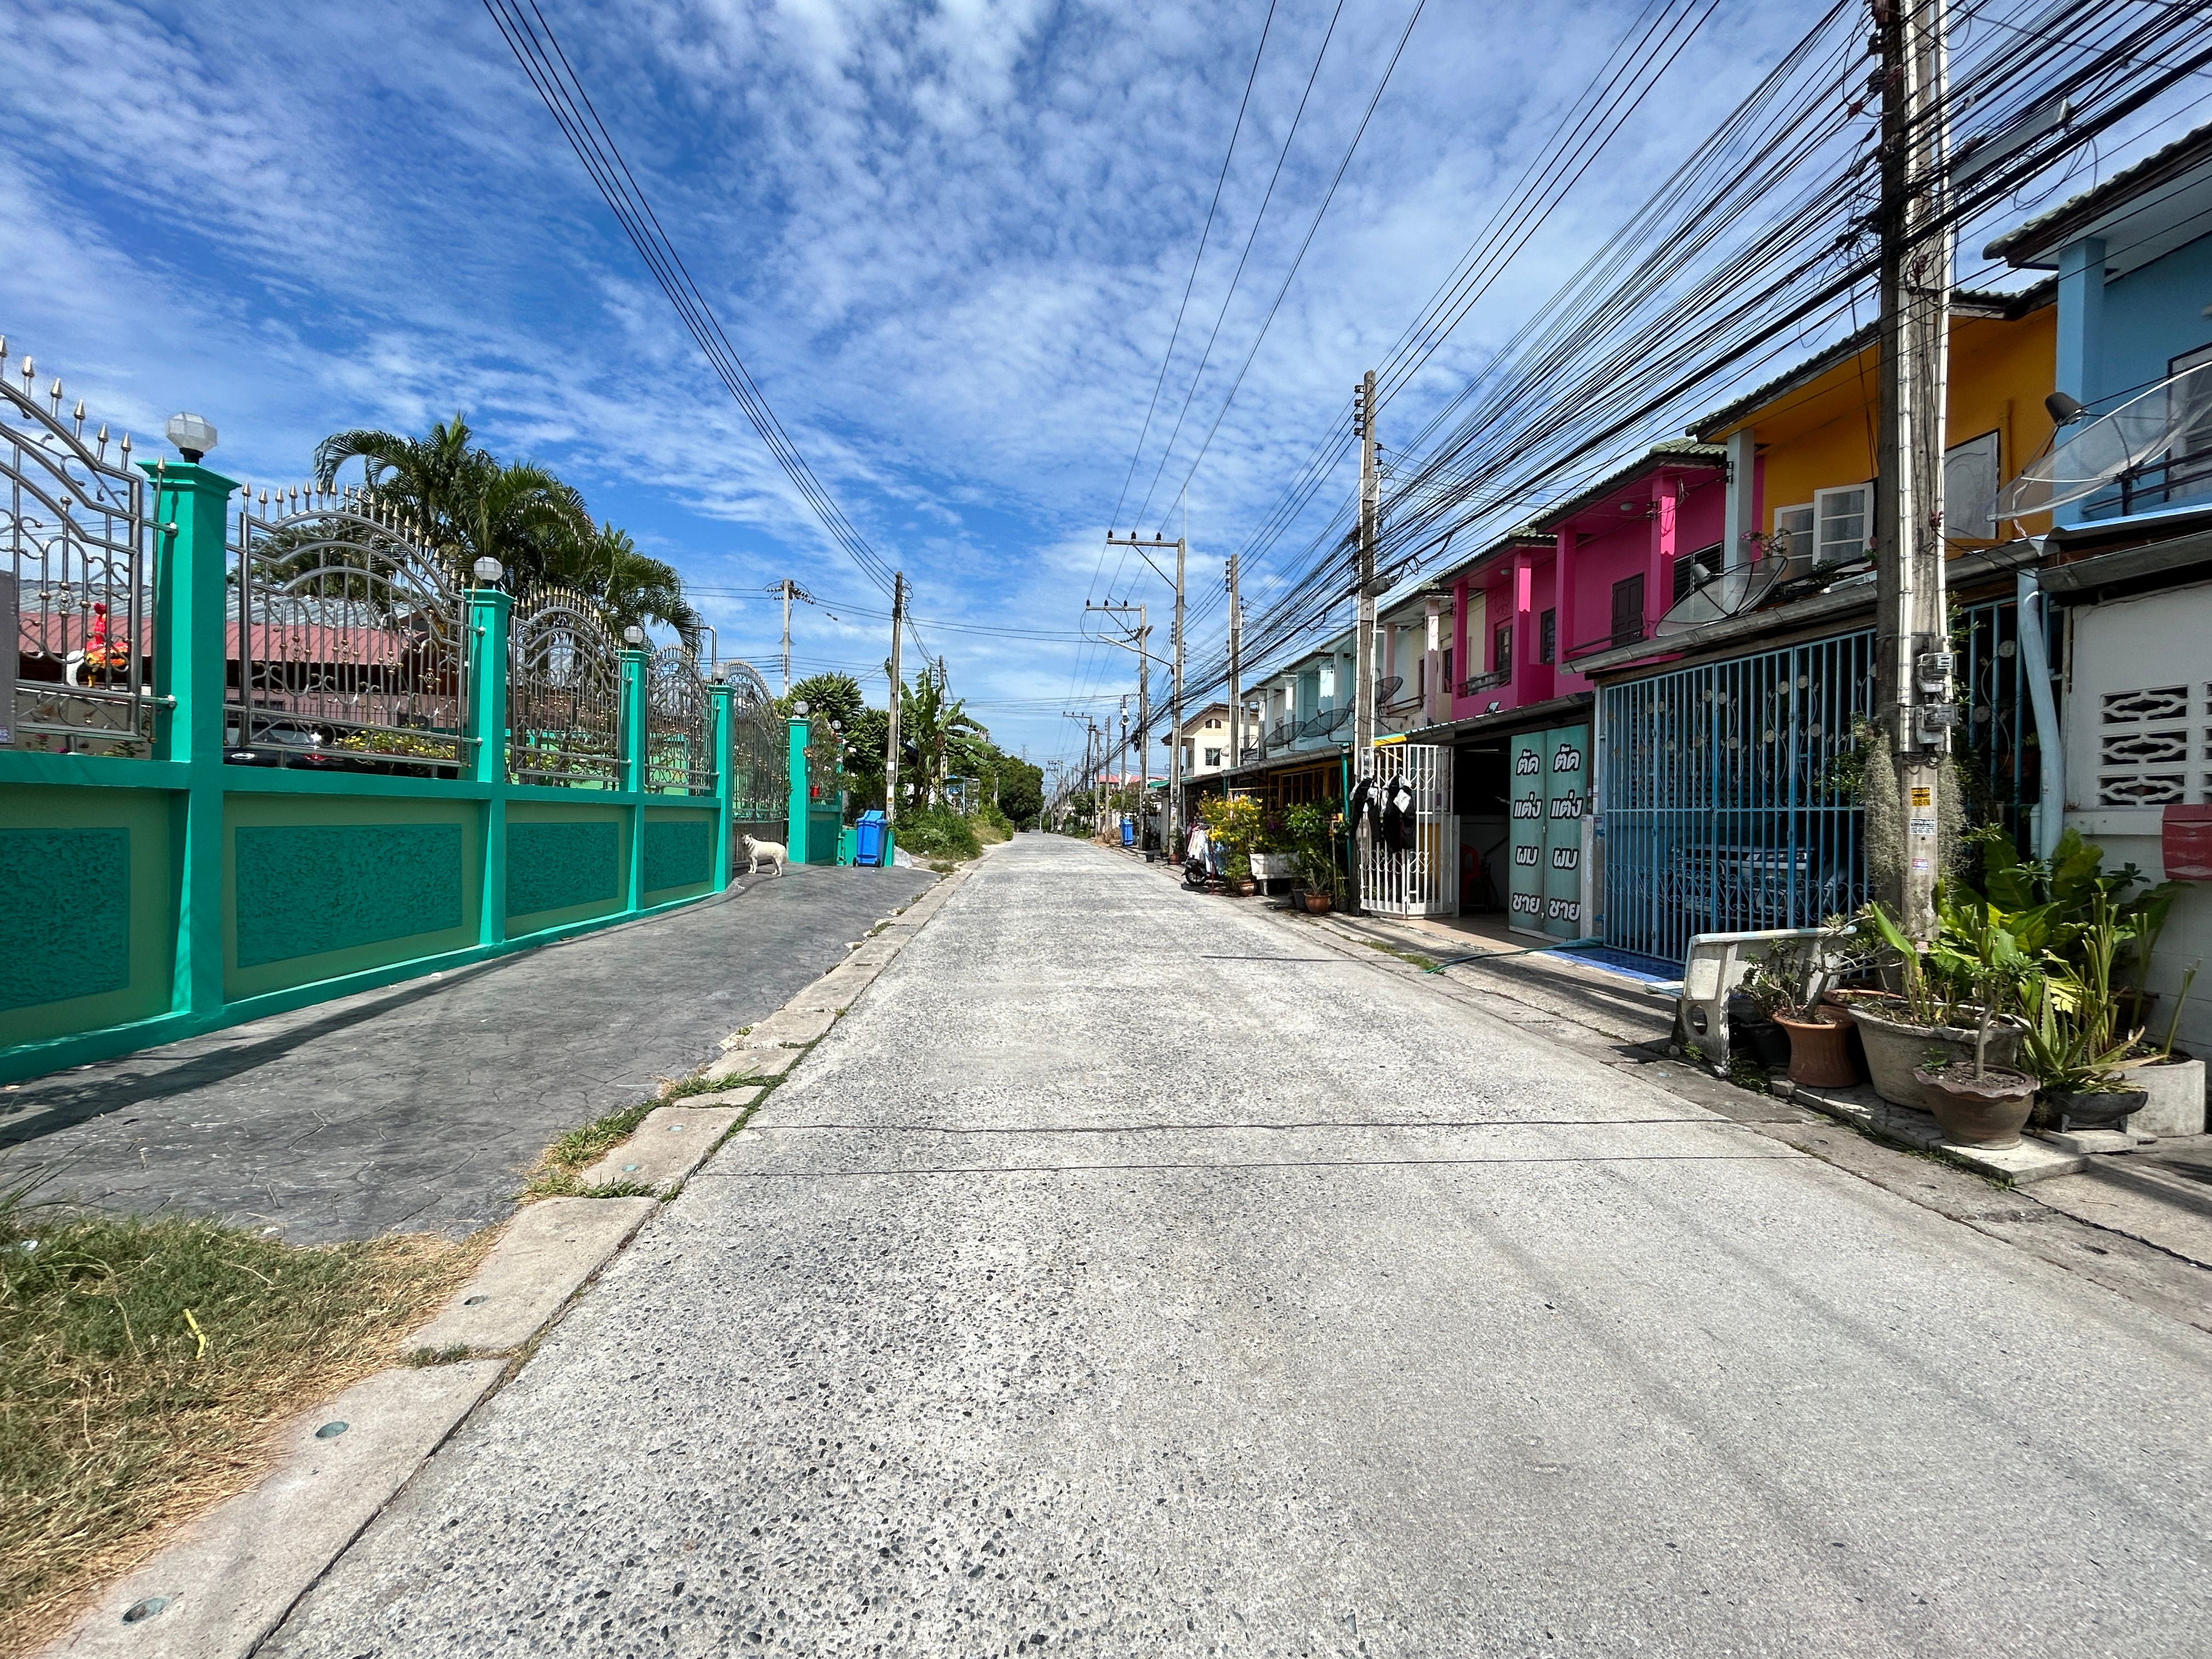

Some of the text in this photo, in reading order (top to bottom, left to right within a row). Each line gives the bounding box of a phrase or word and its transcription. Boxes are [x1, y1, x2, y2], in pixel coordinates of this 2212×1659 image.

[1516, 749, 1539, 775] ตัด
[1554, 744, 1581, 772] ตัด
[1514, 792, 1542, 818] แต่ง
[1550, 790, 1583, 818] แต่ง
[1516, 847, 1538, 865] ผม
[1553, 848, 1578, 870] ผม
[1513, 893, 1541, 915] ชาย
[1549, 899, 1580, 922] ชาย
